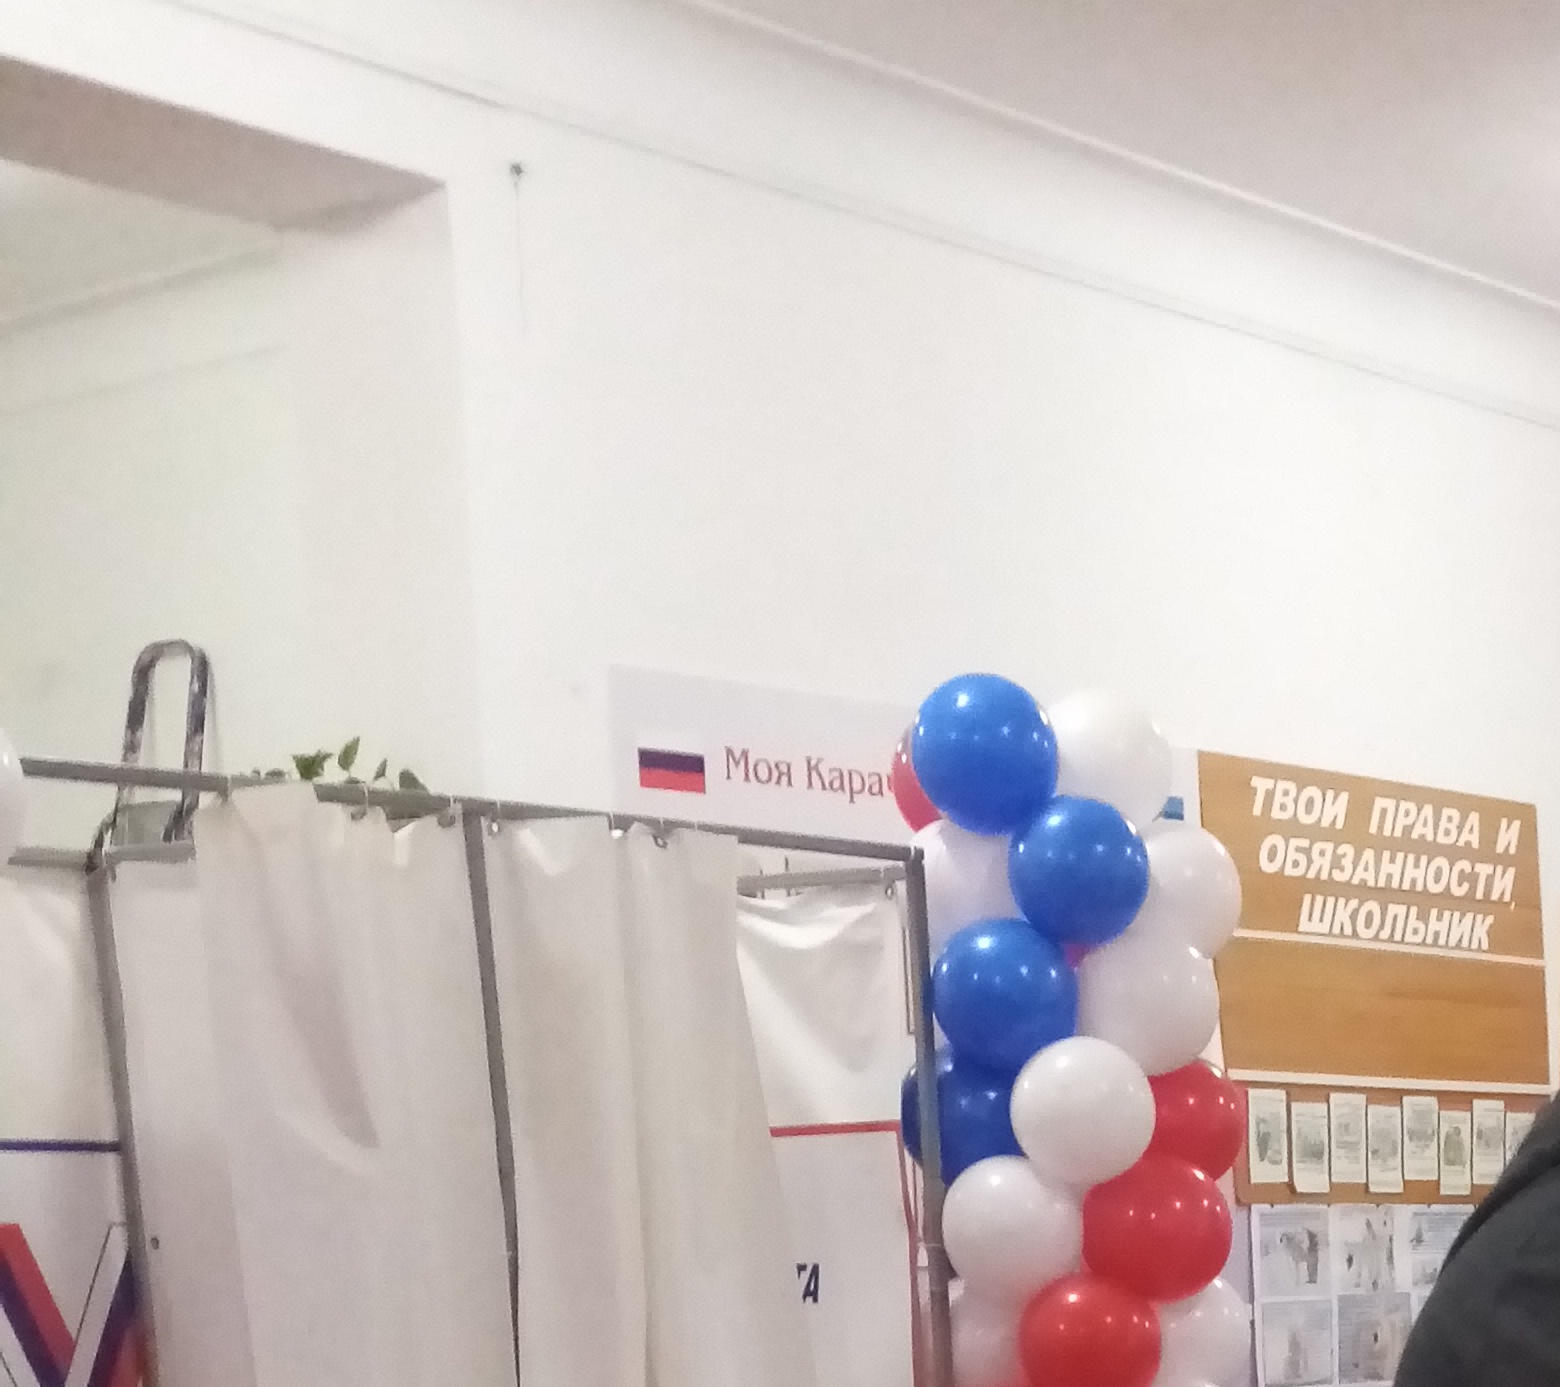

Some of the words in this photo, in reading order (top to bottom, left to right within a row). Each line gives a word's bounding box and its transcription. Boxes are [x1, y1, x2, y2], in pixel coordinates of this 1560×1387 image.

[724, 746, 794, 788] Моя
[1250, 775, 1350, 830] ТВОИ
[1368, 796, 1480, 850] ПРАВА
[1495, 817, 1521, 855] И
[1259, 833, 1517, 912] ОБЯЗАННОСТИ,
[1298, 893, 1495, 951] ШКОЛЬНИК
